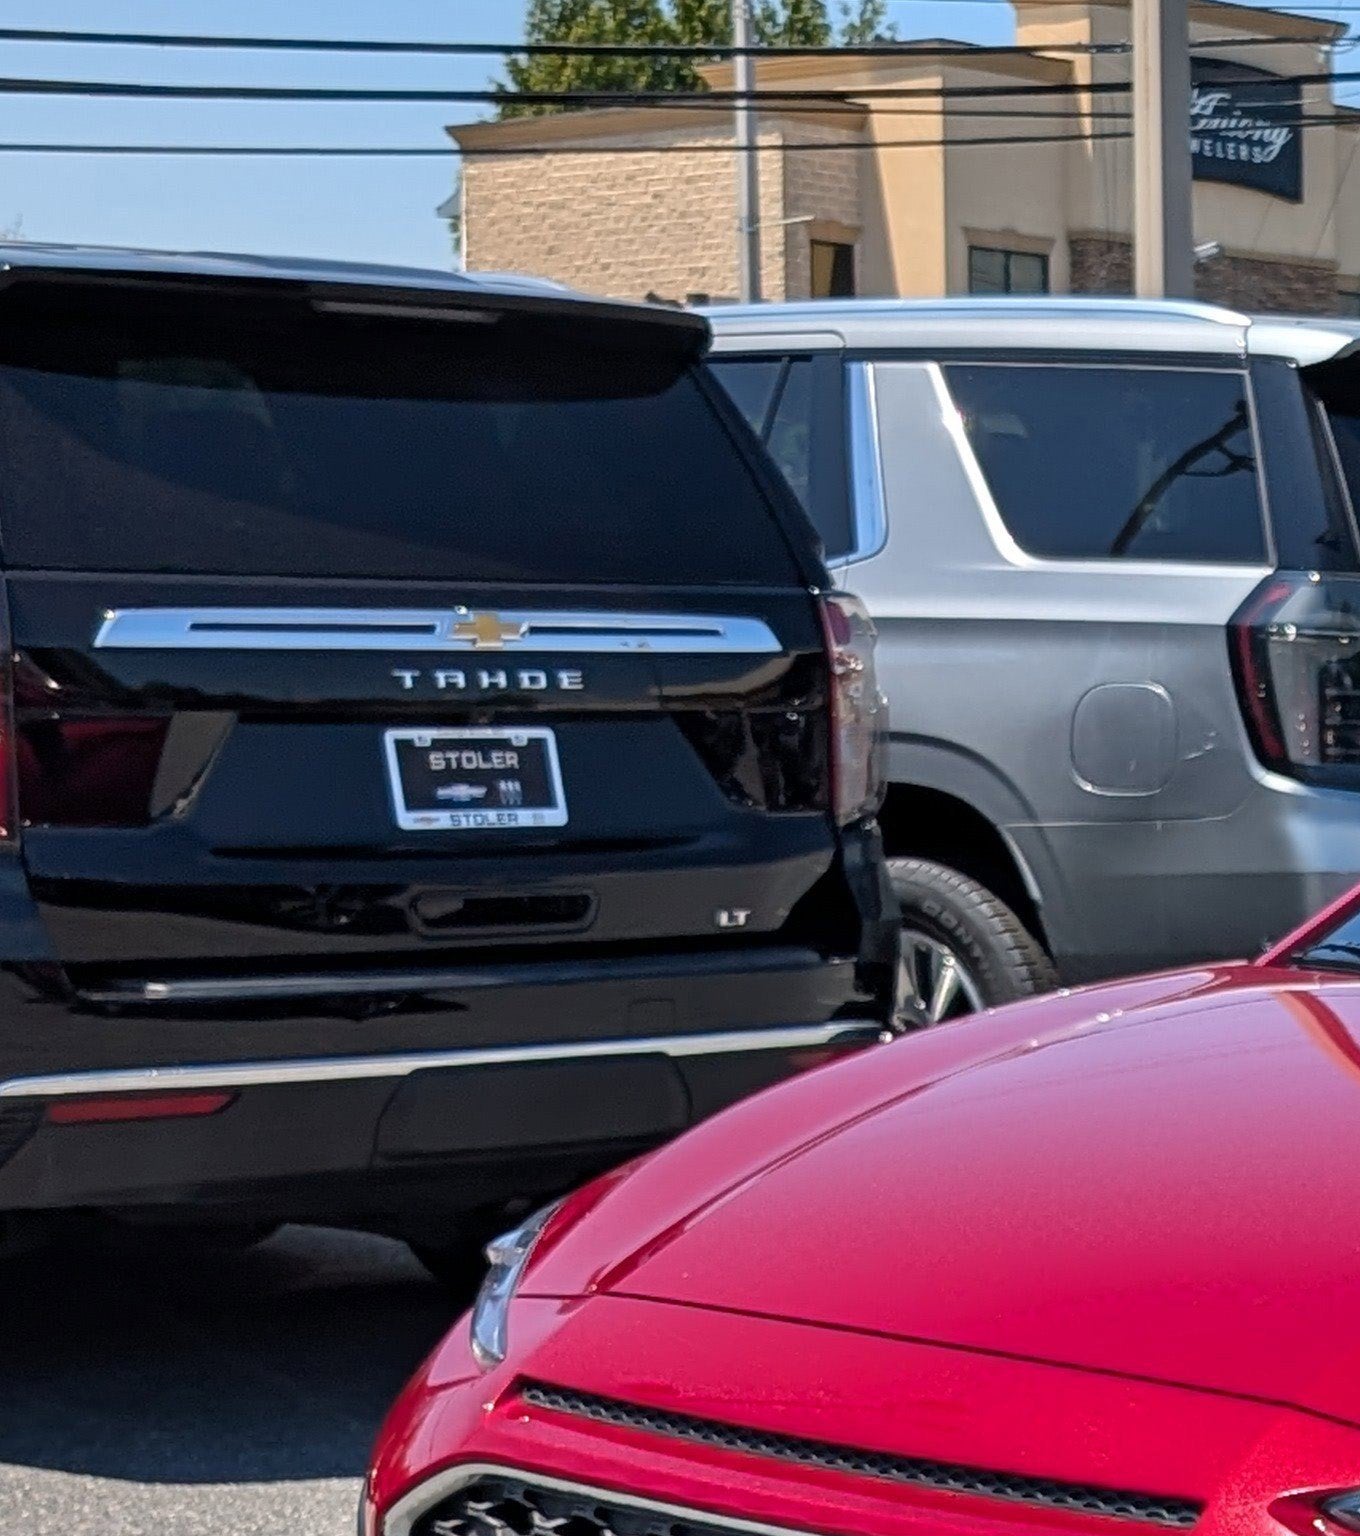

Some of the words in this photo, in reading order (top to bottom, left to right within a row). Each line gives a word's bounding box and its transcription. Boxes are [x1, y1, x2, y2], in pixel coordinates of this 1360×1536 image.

[392, 668, 584, 690] TAHOE
[429, 750, 519, 770] STOLER
[719, 908, 751, 927] LT
